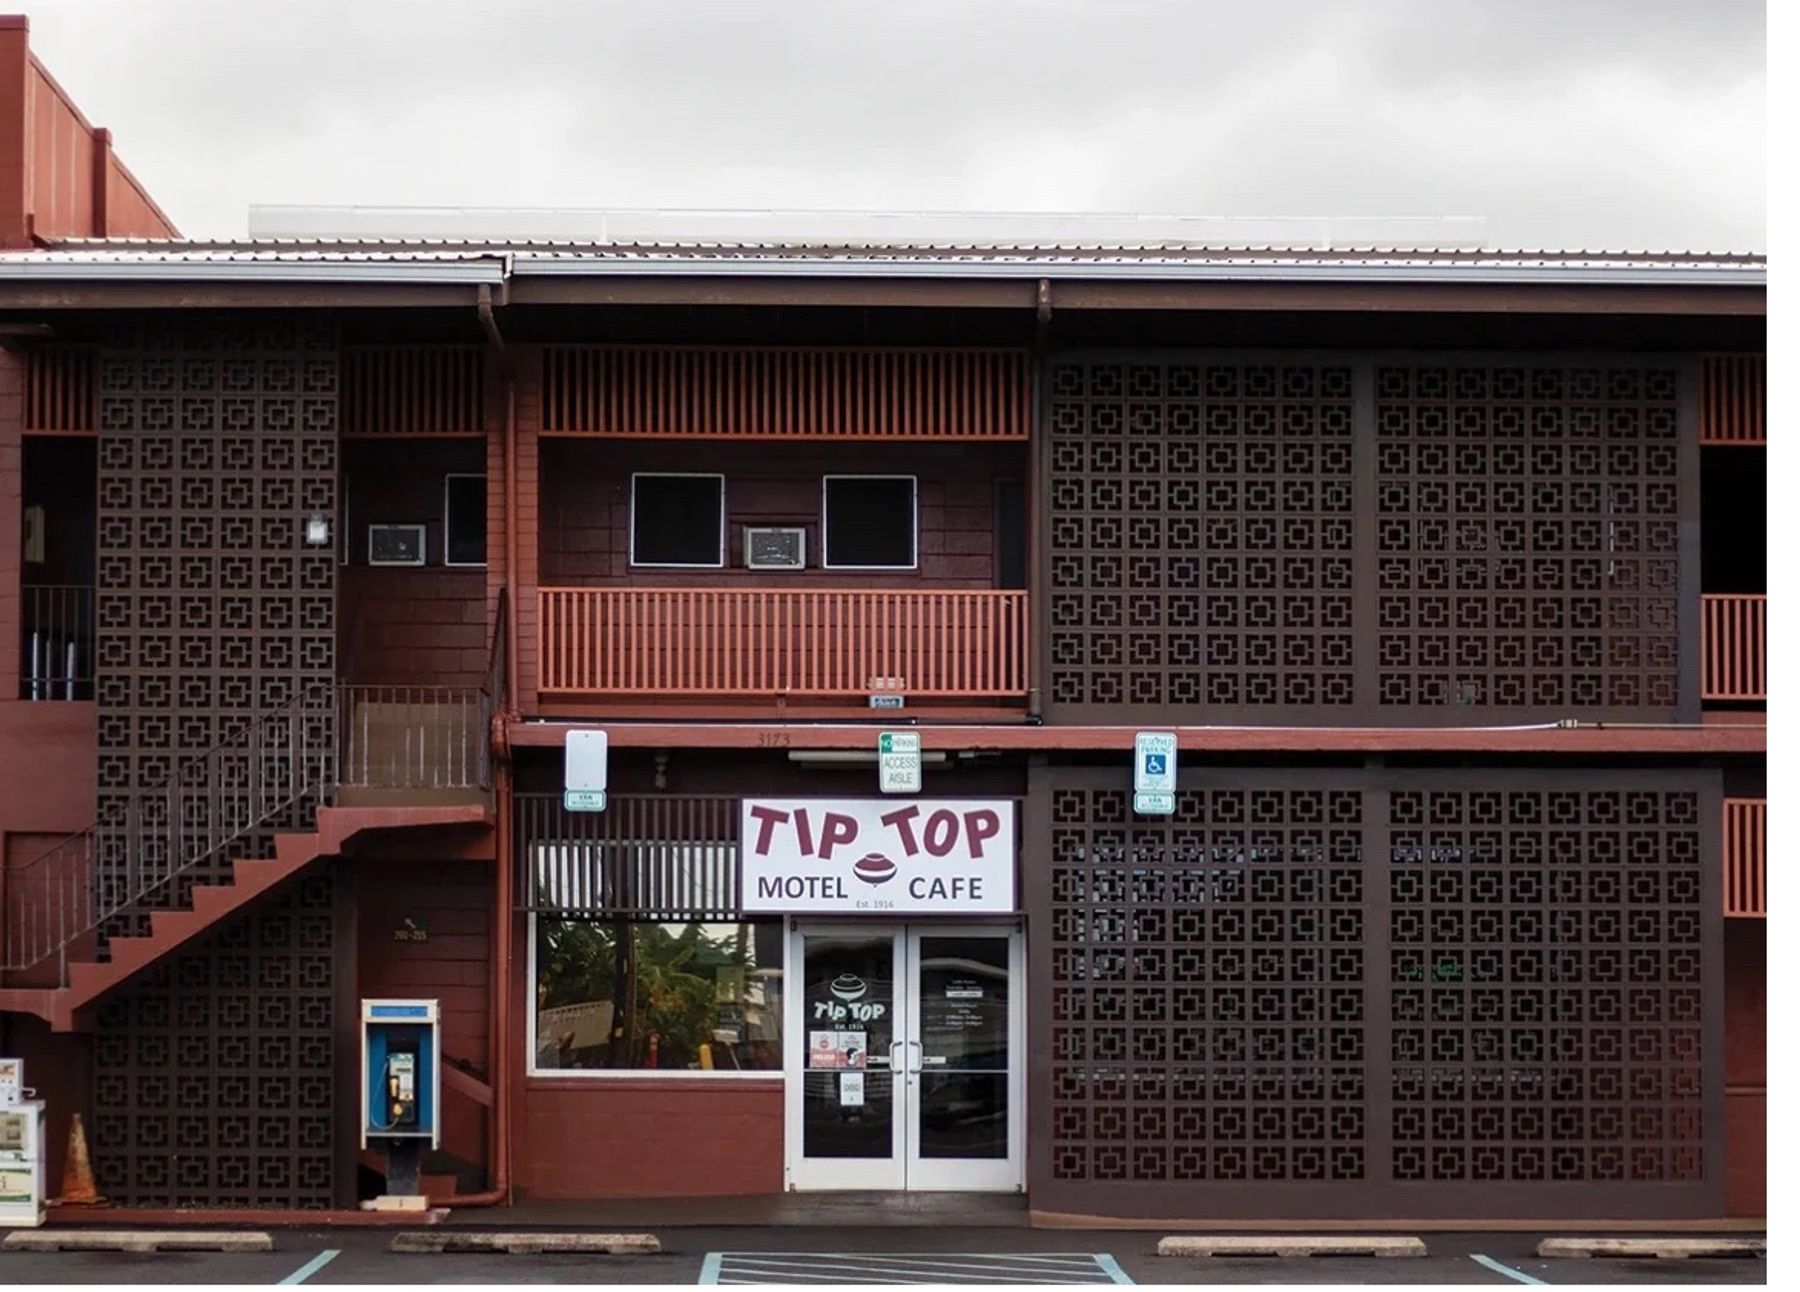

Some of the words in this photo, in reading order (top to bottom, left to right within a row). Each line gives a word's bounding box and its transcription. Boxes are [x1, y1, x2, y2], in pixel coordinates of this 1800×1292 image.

[758, 732, 791, 746] 3173
[885, 756, 917, 769] ACCESS
[889, 772, 913, 784] AISLE
[750, 805, 858, 860] TIP
[880, 804, 1000, 859] TOP
[758, 876, 849, 899] MOTEL
[909, 877, 983, 899] CAFE
[874, 900, 894, 908] 1916
[848, 1002, 886, 1022] TOP
